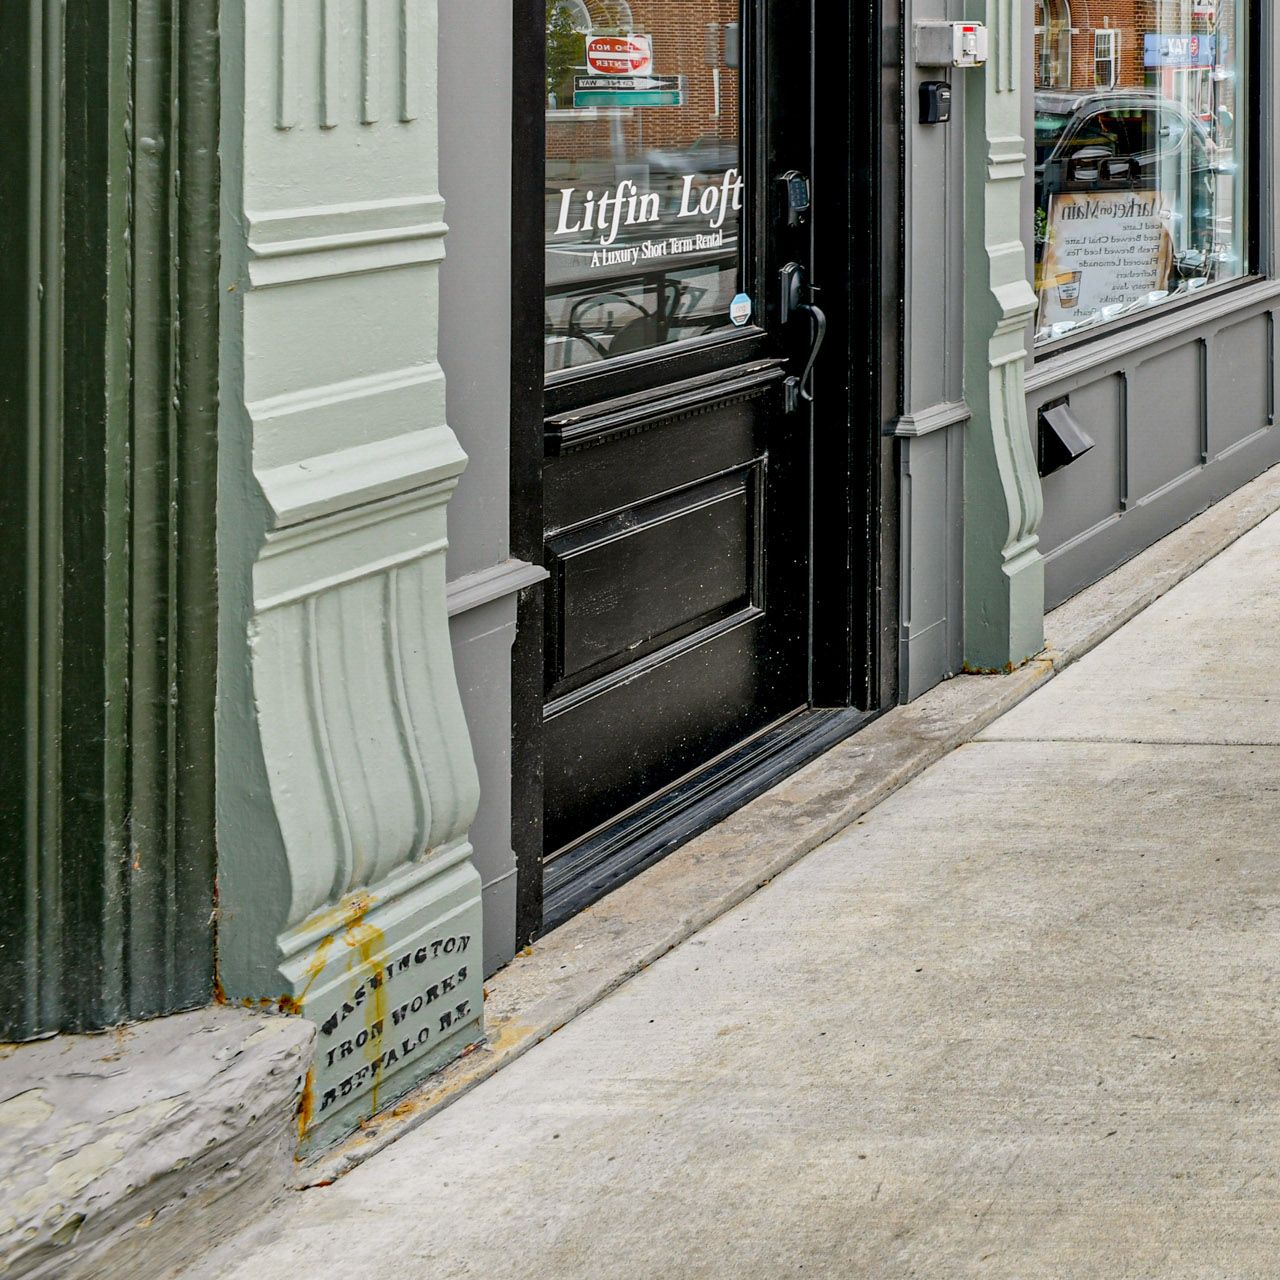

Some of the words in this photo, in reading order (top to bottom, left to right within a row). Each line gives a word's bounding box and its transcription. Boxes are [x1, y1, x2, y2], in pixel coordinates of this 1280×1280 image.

[554, 179, 660, 246] Litfin
[677, 167, 745, 229] Loft
[590, 252, 600, 268] A
[602, 245, 639, 266] Luxury
[642, 239, 667, 259] Short
[668, 235, 693, 255] Term
[695, 229, 723, 250] Rental
[320, 935, 472, 1036] WASHINGTON
[326, 1018, 384, 1067] IRON
[391, 966, 468, 1027] WORKS
[319, 1027, 430, 1112] BUFFALO
[438, 999, 472, 1032] N.Y.
